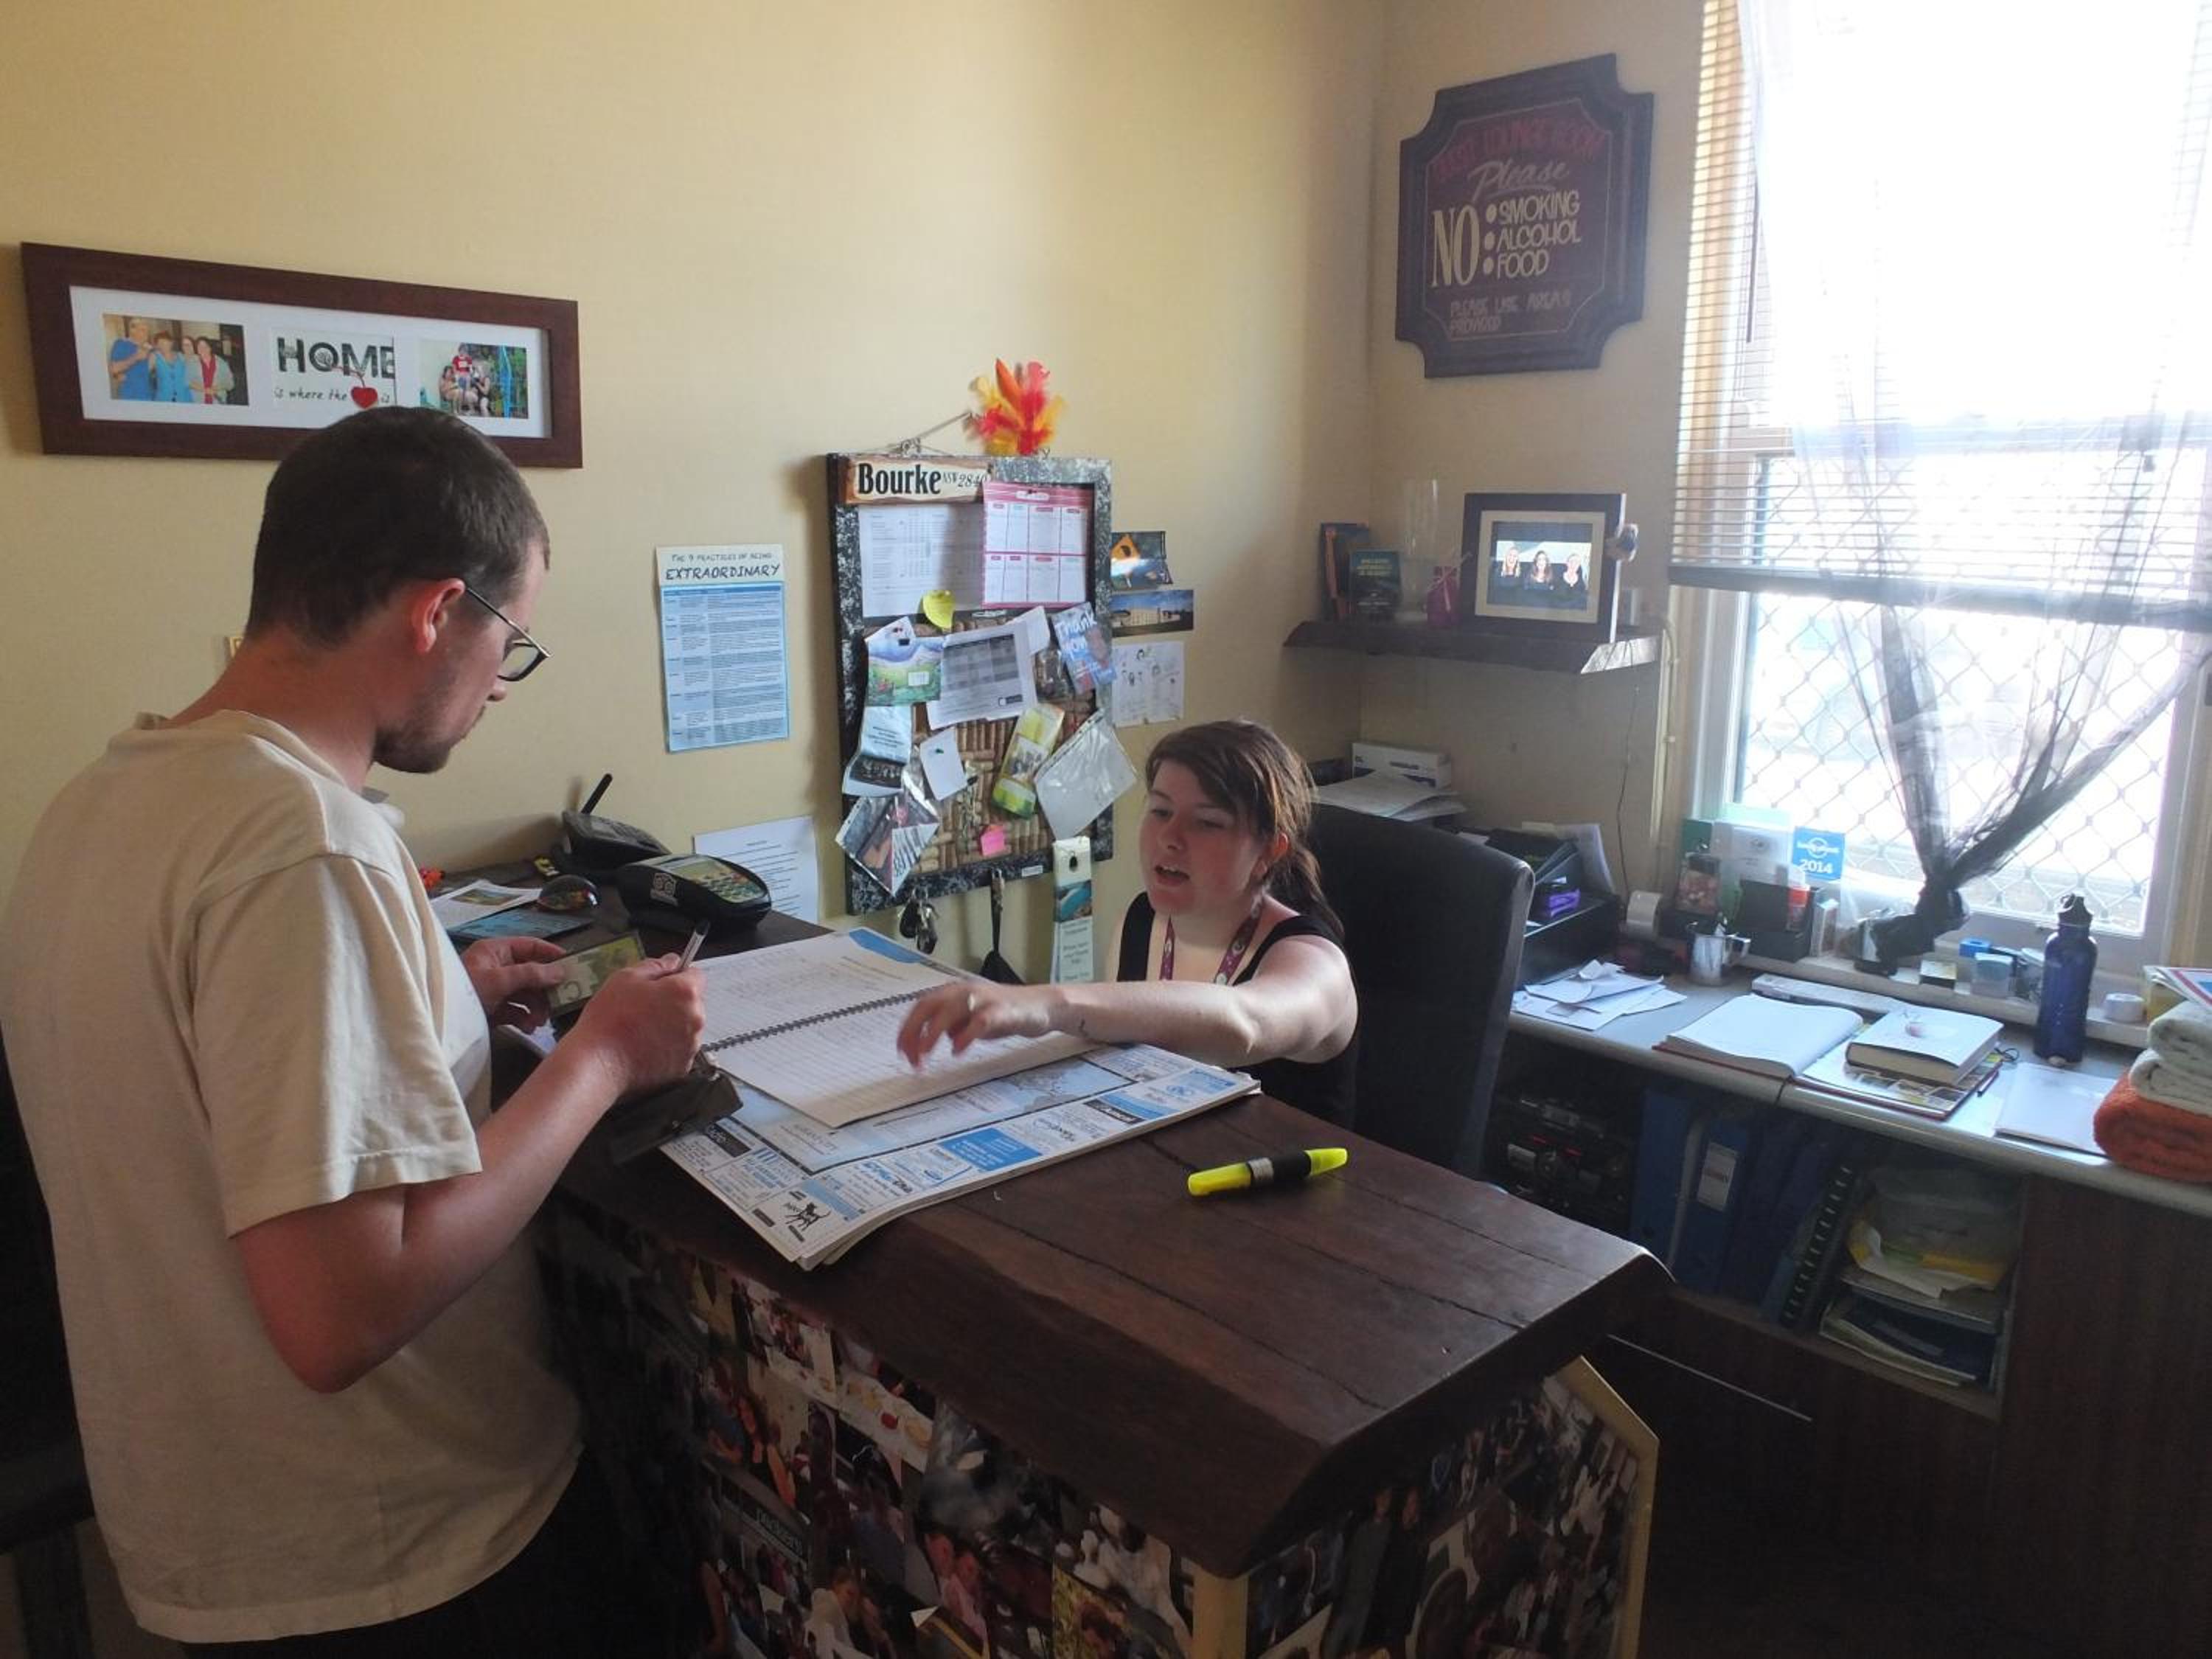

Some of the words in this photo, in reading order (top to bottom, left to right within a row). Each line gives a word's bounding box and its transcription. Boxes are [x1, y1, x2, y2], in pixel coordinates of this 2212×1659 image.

[1467, 157, 1570, 202] Please
[1498, 189, 1582, 225] SMOKING
[1497, 219, 1582, 252] ALCOHOL
[1496, 248, 1550, 279] FOOD
[276, 336, 397, 379] HOME
[274, 387, 284, 399] is
[288, 387, 324, 400] where
[328, 389, 348, 402] the
[858, 462, 942, 495] Bourke
[665, 563, 781, 580] EXTRAORDINARY
[672, 554, 685, 562] THE
[1799, 858, 1834, 874] 2014
